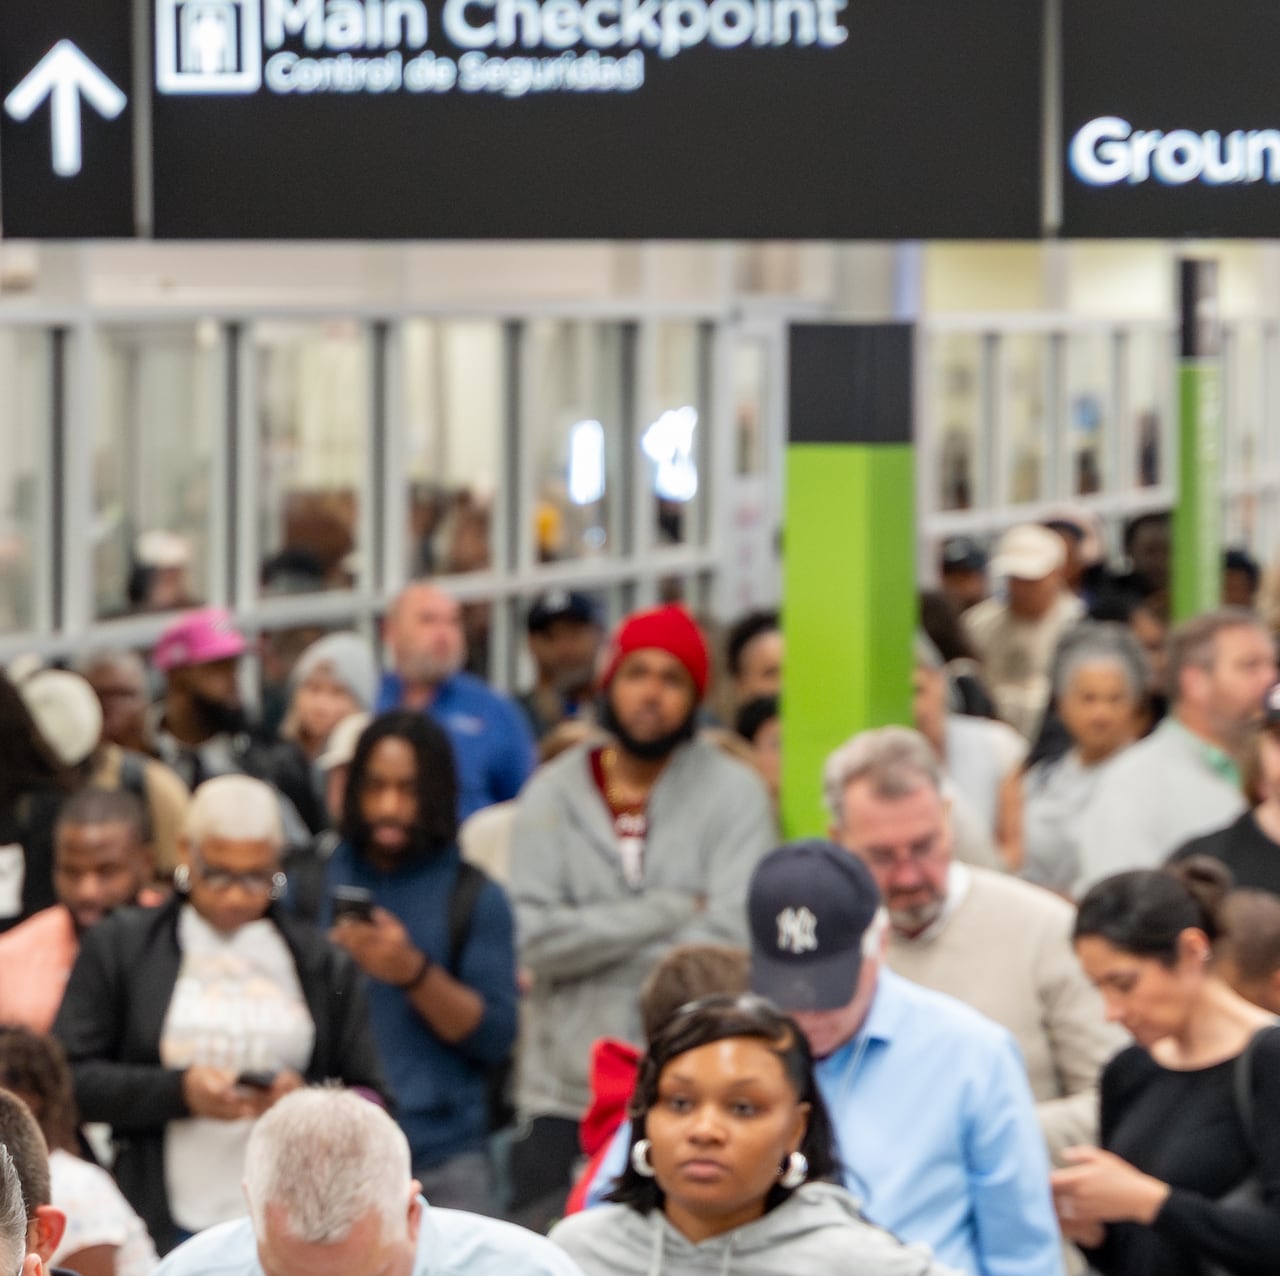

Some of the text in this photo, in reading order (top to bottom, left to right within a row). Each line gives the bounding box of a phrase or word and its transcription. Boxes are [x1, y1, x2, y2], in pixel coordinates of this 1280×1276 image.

[263, 0, 848, 58] Main Checkpoint
[265, 49, 645, 97] Control de Seguridad
[1068, 115, 1280, 186] Groun
